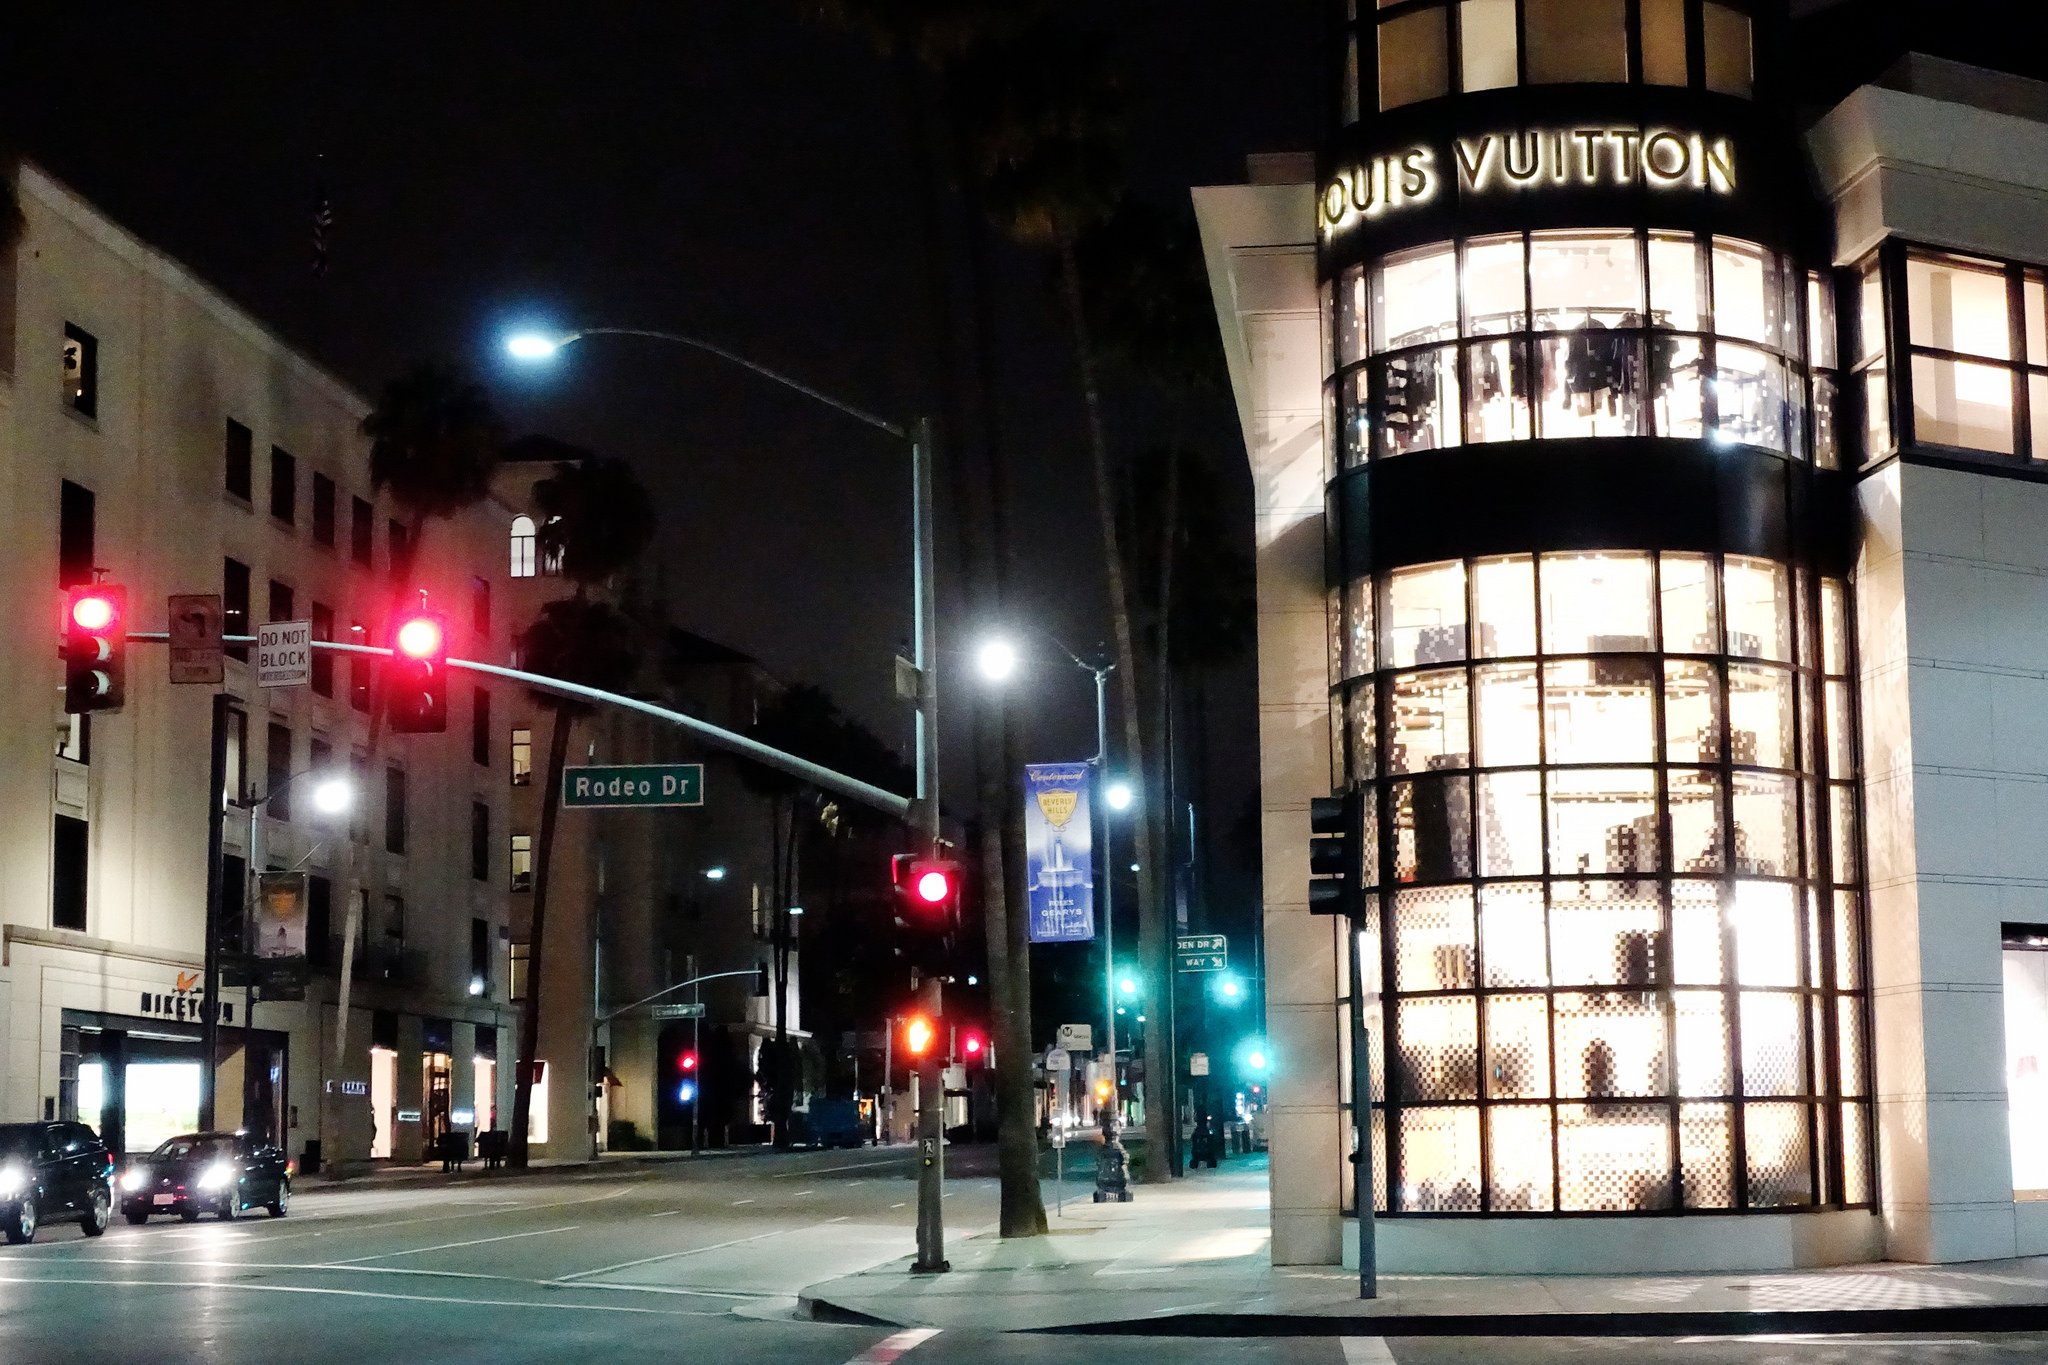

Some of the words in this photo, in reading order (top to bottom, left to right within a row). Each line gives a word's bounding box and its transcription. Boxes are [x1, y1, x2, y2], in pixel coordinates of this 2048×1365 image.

[1318, 149, 1427, 230] OUIS
[1452, 129, 1736, 190] VUITTON
[261, 632, 278, 646] DO
[281, 630, 306, 645] NOT
[260, 651, 306, 668] BLOCK
[576, 777, 650, 797] Rodeo
[662, 775, 689, 796] Dr
[1041, 909, 1082, 917] GEARYS
[1197, 940, 1209, 948] DR
[1185, 958, 1205, 967] WAY
